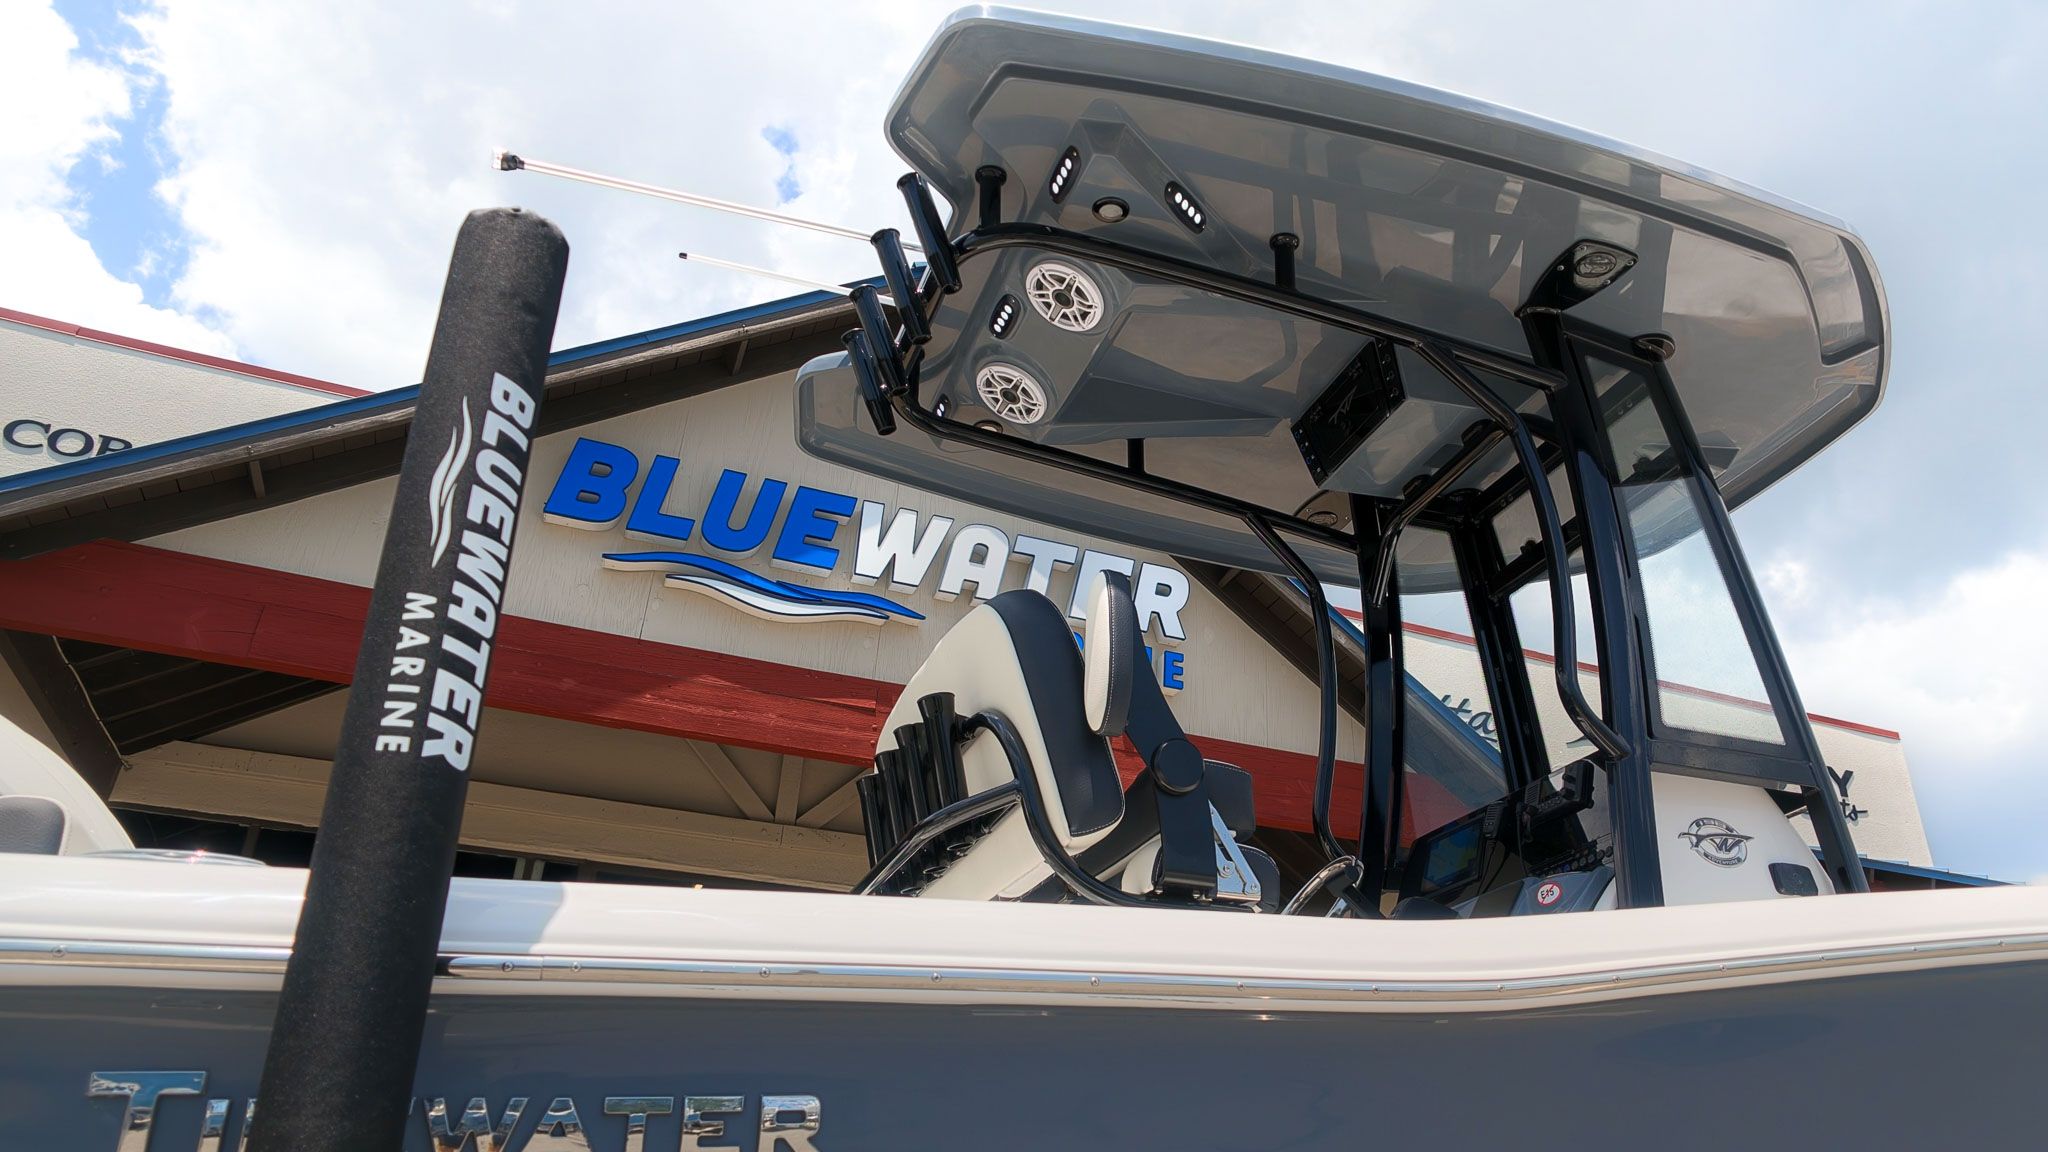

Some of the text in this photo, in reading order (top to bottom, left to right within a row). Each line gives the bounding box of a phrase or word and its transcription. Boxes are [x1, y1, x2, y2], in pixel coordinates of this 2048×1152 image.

[420, 371, 536, 772] BLUEWATER
[375, 591, 438, 753] MARINE
[87, 1071, 822, 1152] TIWATER
